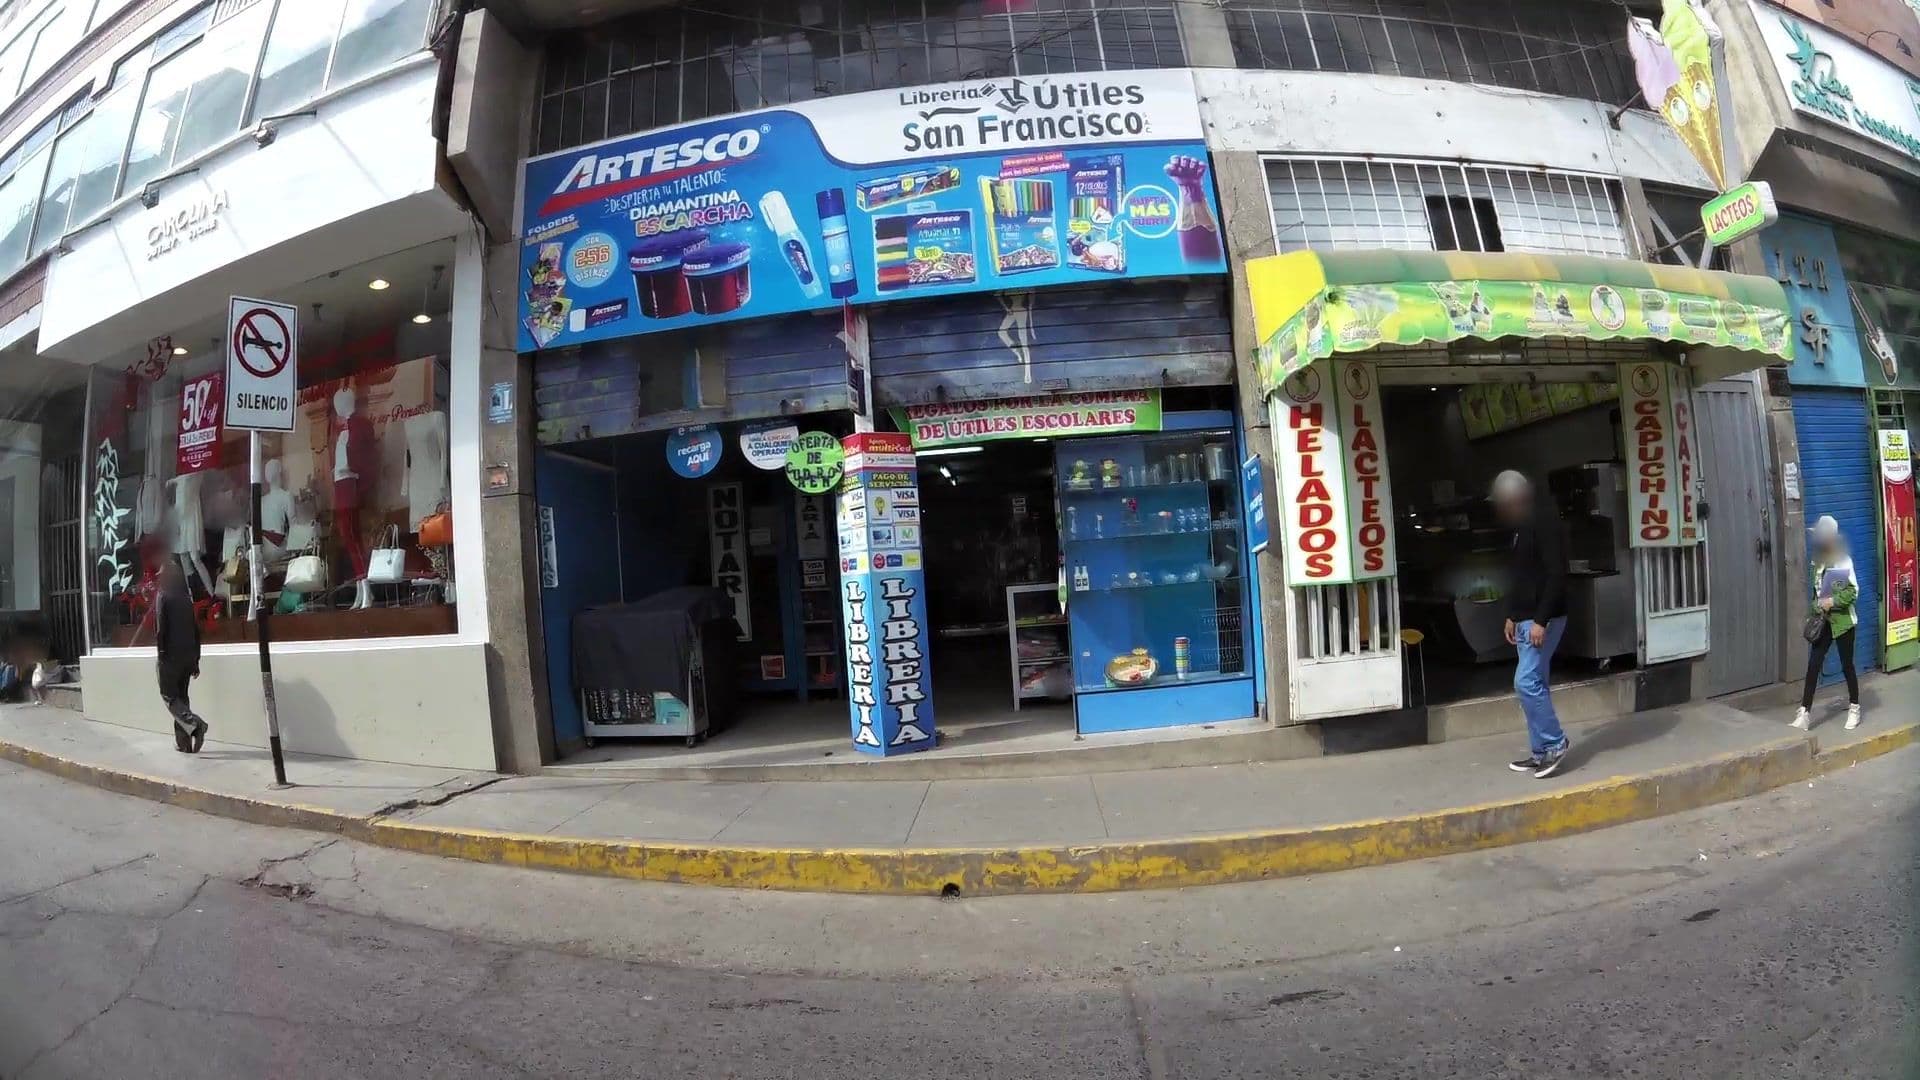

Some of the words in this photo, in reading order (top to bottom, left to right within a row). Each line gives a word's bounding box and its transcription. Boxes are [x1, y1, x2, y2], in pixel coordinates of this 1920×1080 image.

[1033, 79, 1144, 110] Útiles
[903, 122, 964, 152] San
[977, 109, 1143, 145] Francisco
[609, 187, 661, 214] DESPIERTA
[674, 170, 722, 195] TALENTO
[629, 189, 741, 220] DIAMANTINA
[527, 213, 576, 236] FOLDERS
[635, 201, 754, 239] ESCARCHA
[1129, 201, 1171, 217] MÁS
[1708, 194, 1755, 234] LACTEOS
[574, 244, 610, 268] 256
[236, 393, 288, 411] SILENCIO
[917, 422, 945, 440] DE
[949, 417, 1017, 437] ÚTILES
[1022, 409, 1136, 430] ESCOLARES
[677, 441, 712, 456] recarga
[791, 434, 835, 454] OFERTA
[806, 452, 822, 465] DE
[1634, 400, 1670, 541] CAPUCHINO
[1675, 402, 1693, 522] CAFE
[895, 490, 916, 500] VISA
[1289, 402, 1337, 578] HELADOS
[1351, 403, 1386, 572] LACTEOS
[896, 509, 916, 519] VISA
[846, 581, 881, 747] LIBRERIA
[880, 577, 931, 747] LIBRERIA
